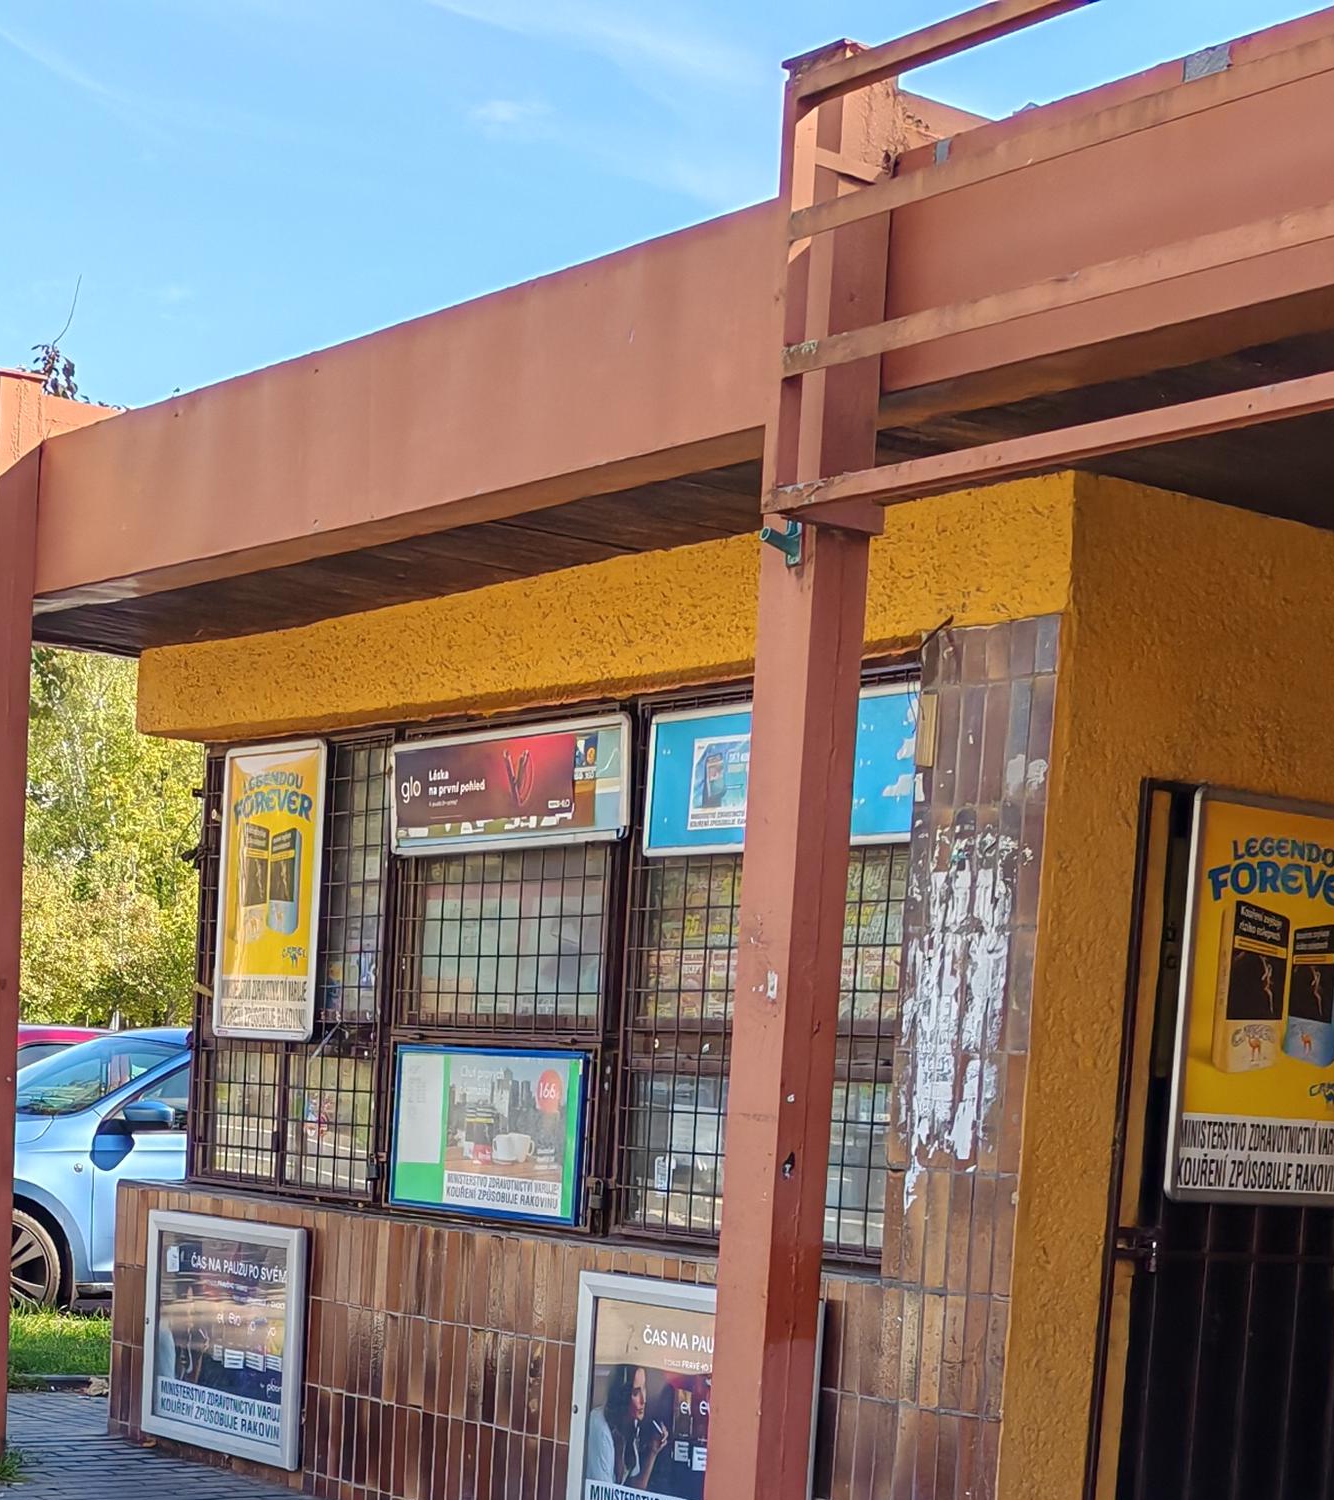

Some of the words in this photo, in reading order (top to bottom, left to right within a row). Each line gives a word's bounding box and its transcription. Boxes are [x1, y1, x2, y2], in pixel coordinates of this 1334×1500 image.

[428, 786, 438, 796] na
[439, 781, 460, 797] první
[460, 778, 486, 795] pohled
[429, 769, 449, 781] Láska
[401, 776, 421, 803] glo
[539, 1083, 556, 1099] 166
[1179, 1119, 1246, 1151] MINISTERSTVO
[1248, 1121, 1317, 1154] ZDRAVOTNICTVÍ
[1176, 1153, 1228, 1188] KOUŘENÍ
[1229, 1154, 1293, 1190] ZPŮSOBUJE
[477, 1188, 517, 1205] ZPŮSOBUJE
[520, 1195, 558, 1210] RAKOVINU
[191, 1252, 207, 1270] ČAS
[208, 1258, 222, 1273] NA
[249, 1264, 259, 1279] PO
[643, 1324, 668, 1346] ČAS
[670, 1331, 688, 1350] NA
[160, 1379, 206, 1404] MINISTERSTVO
[206, 1391, 256, 1415] ZDRAVOTNICTVÍ
[160, 1396, 194, 1418] KOUŘENÍ
[194, 1405, 238, 1431] ZPŮSOBUJE
